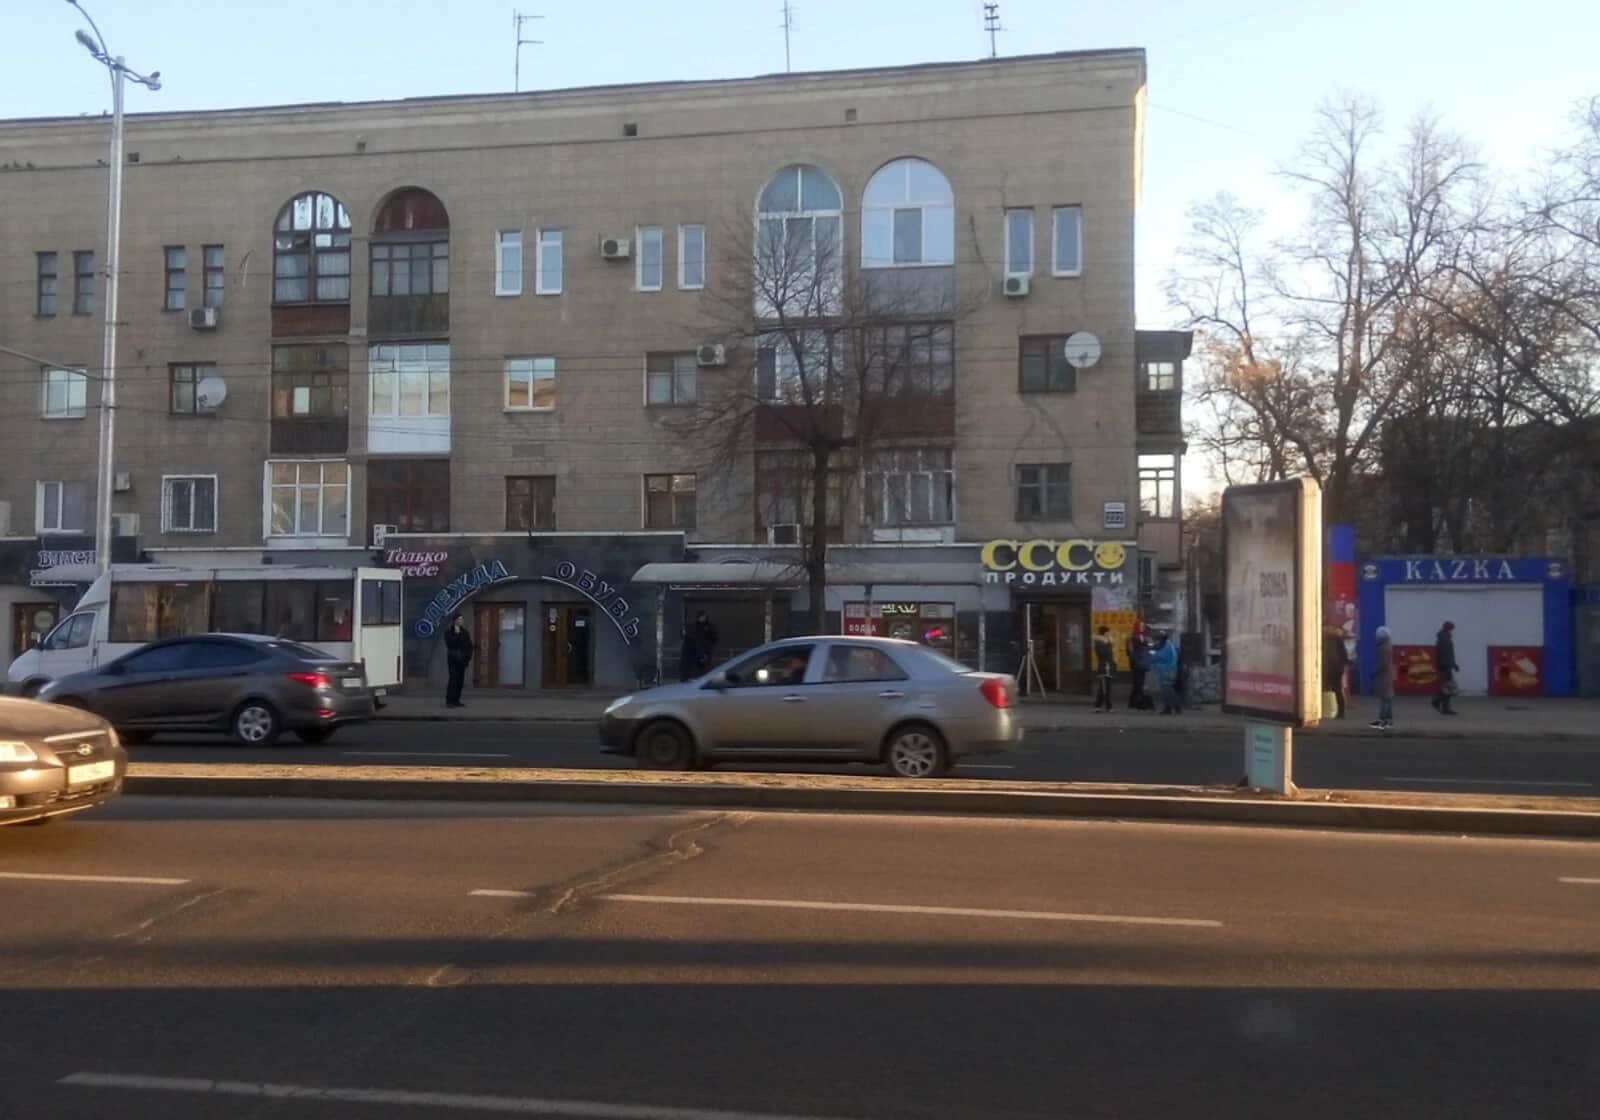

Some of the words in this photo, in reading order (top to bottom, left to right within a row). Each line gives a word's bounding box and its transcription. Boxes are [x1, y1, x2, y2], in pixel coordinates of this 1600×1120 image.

[985, 572, 1124, 585] ПРОДУКТИ
[1406, 559, 1515, 580] KAZKA
[415, 559, 508, 637] ОДЕЖДА
[556, 560, 639, 638] ОБУВЬ
